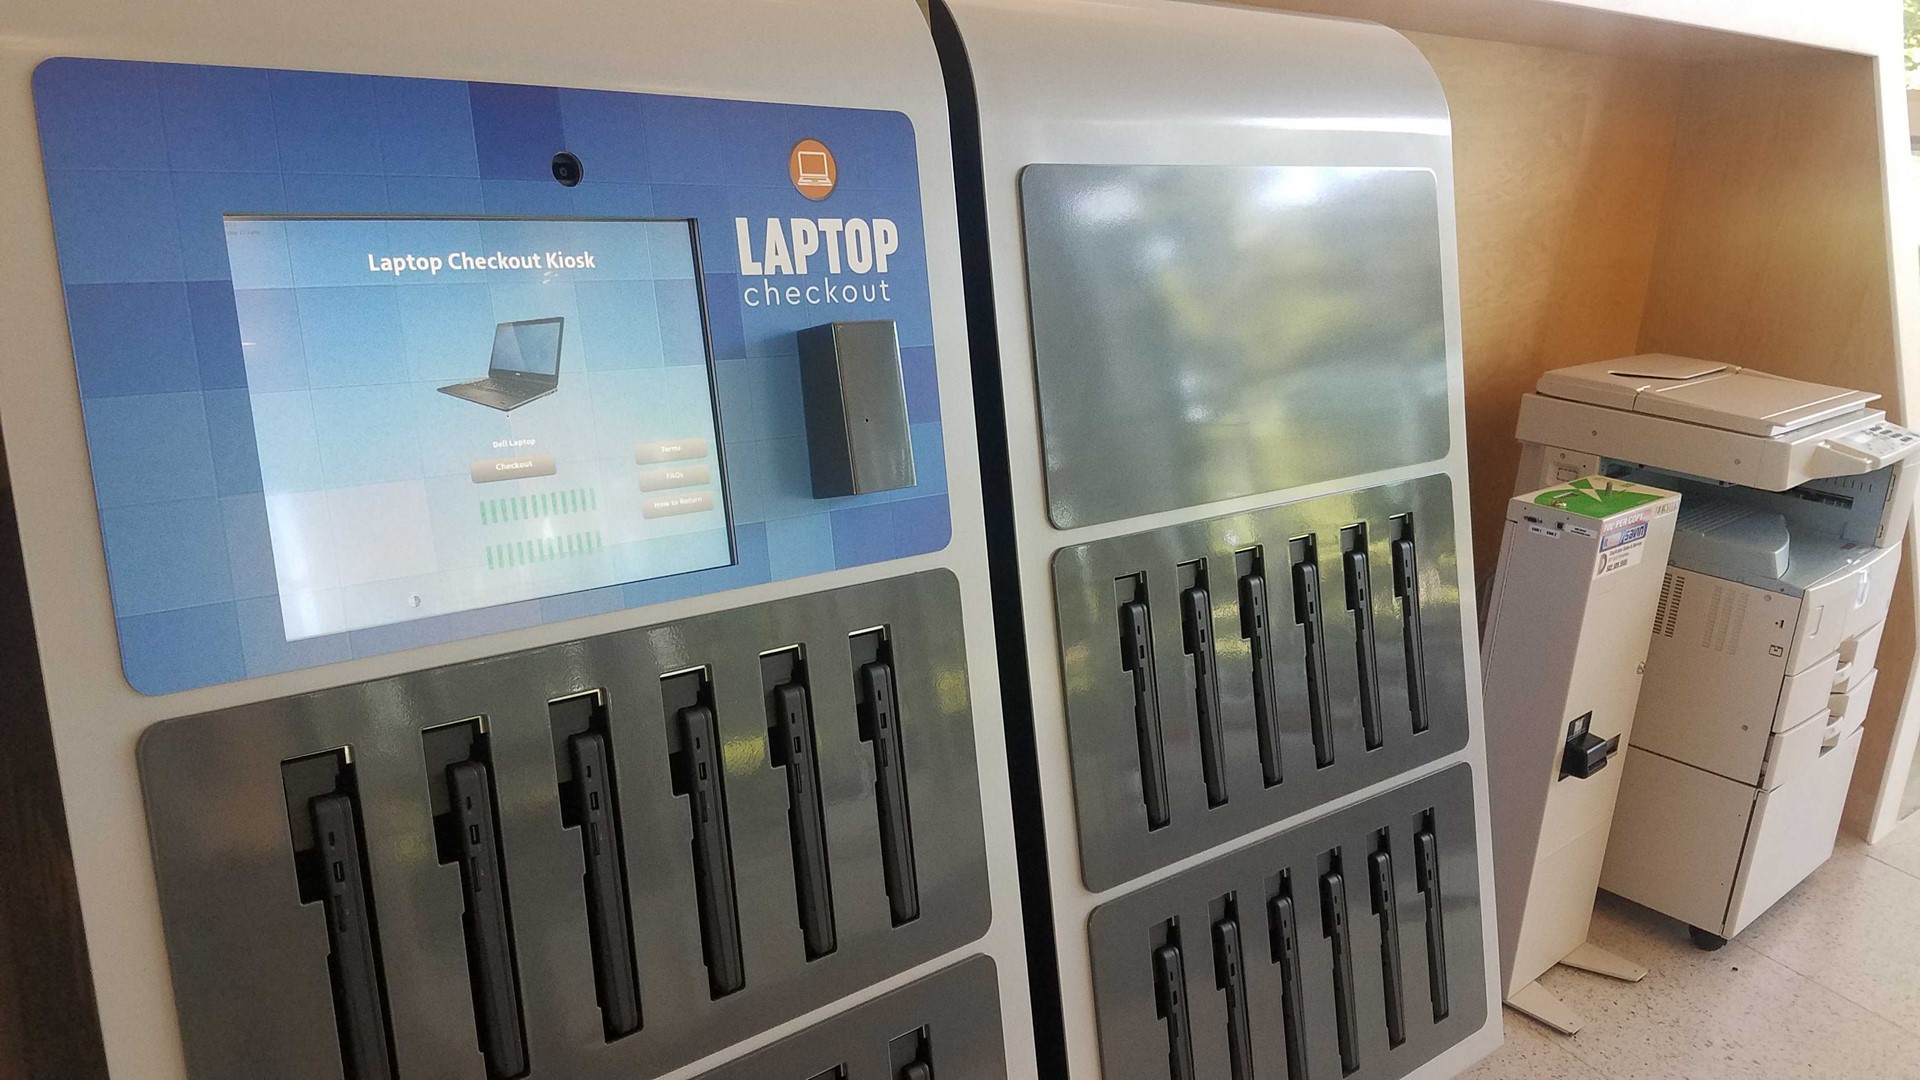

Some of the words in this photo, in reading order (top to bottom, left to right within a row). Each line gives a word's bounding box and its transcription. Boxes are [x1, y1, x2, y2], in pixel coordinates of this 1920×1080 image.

[735, 216, 899, 276] LAPTOP
[368, 253, 443, 276] Laptop
[448, 251, 542, 270] Checkout
[546, 251, 596, 269] Kiosk
[743, 277, 892, 307] checkout
[509, 438, 536, 448] Laptop
[495, 460, 534, 471] Checkout
[666, 471, 684, 480] FAQs
[654, 501, 670, 509] How
[680, 496, 703, 505] Return
